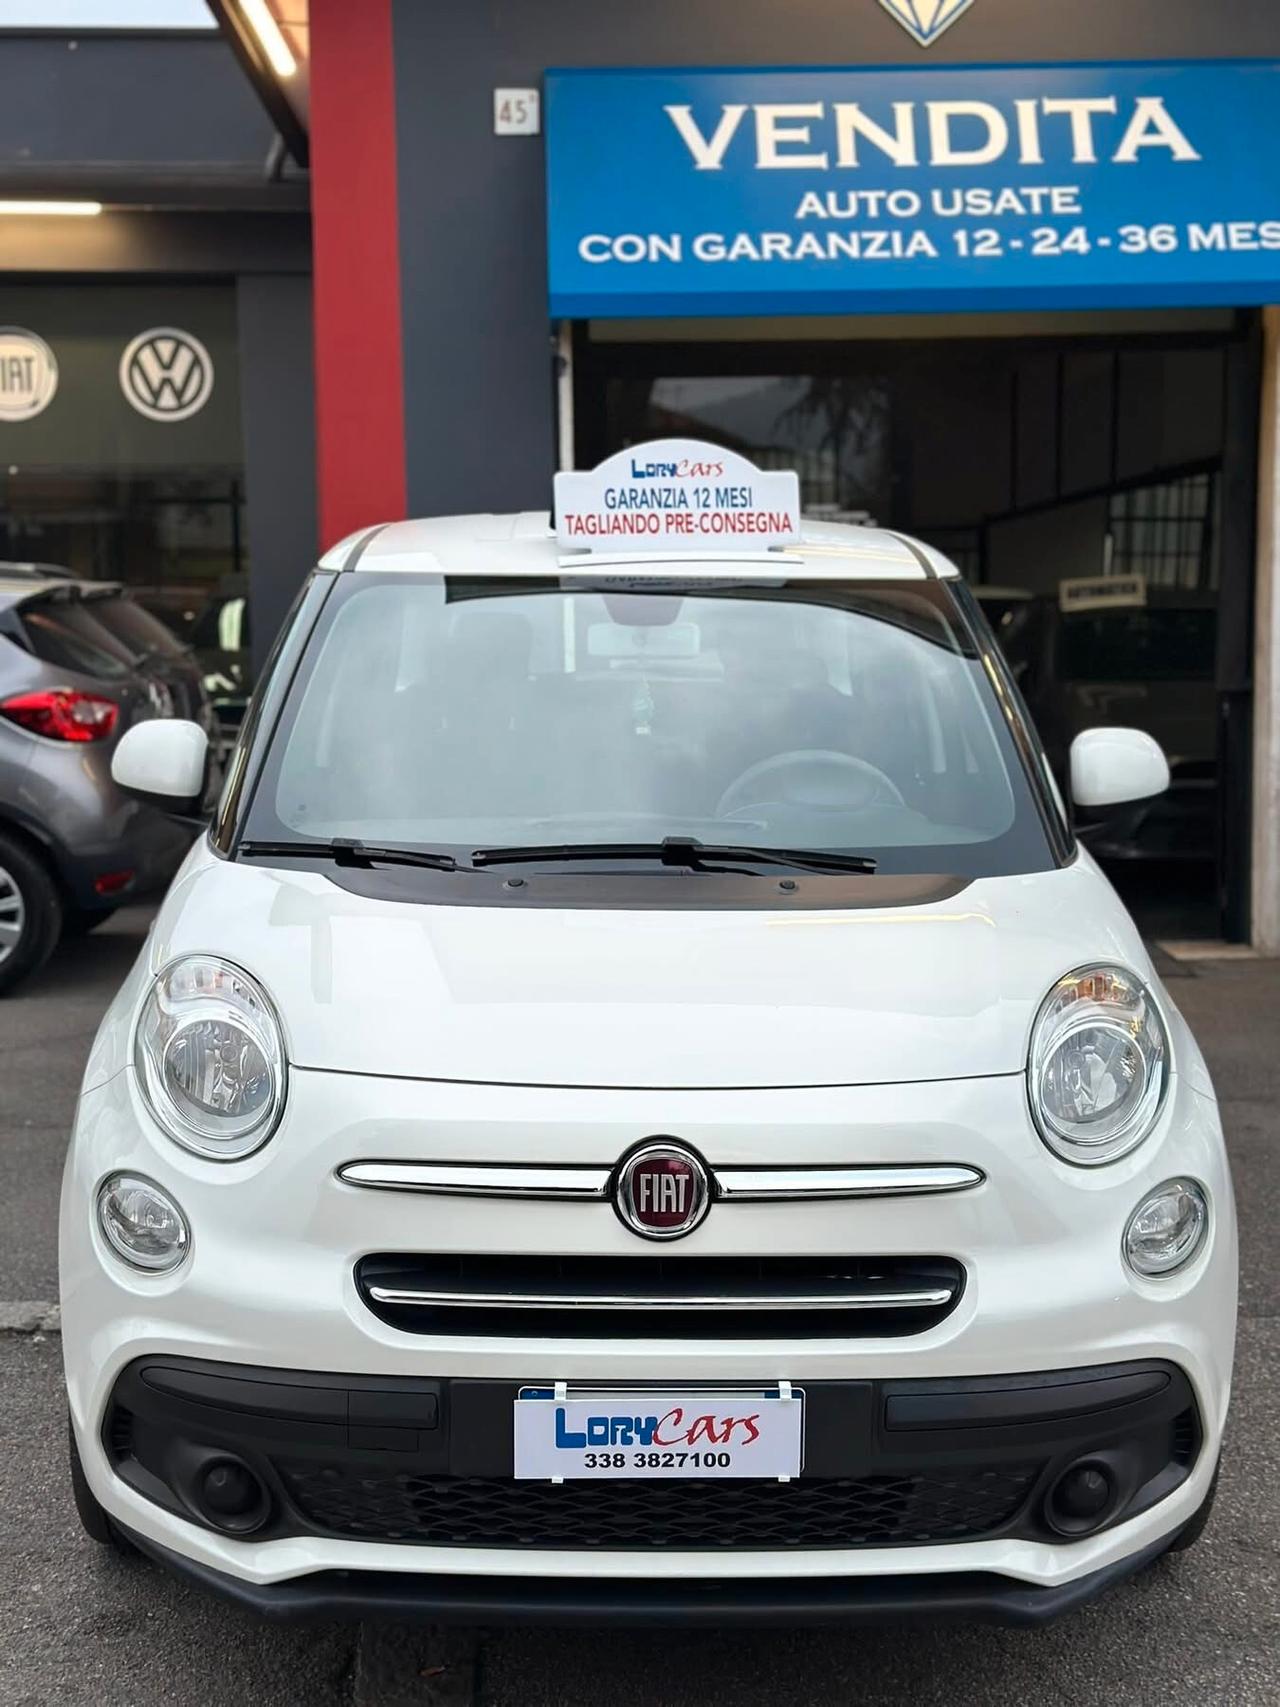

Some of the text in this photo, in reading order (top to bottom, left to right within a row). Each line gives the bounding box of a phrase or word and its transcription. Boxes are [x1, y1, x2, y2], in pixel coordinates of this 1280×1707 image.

[665, 96, 1201, 170] VENDITA
[795, 187, 1081, 218] AUTO USATE
[578, 235, 682, 263] CON
[692, 229, 937, 260] GARANZIA
[953, 228, 1002, 256] 12
[1031, 226, 1090, 255] 24
[1119, 224, 1178, 253] 36
[1187, 222, 1280, 251] MES
[0, 357, 34, 392] IAT
[605, 487, 752, 509] GARANZIA 12 MESI
[565, 512, 793, 535] TAGLIANDO PRE-CONSEGNA
[640, 1173, 690, 1213] FIAT
[584, 1452, 731, 1468] 338 3827100
